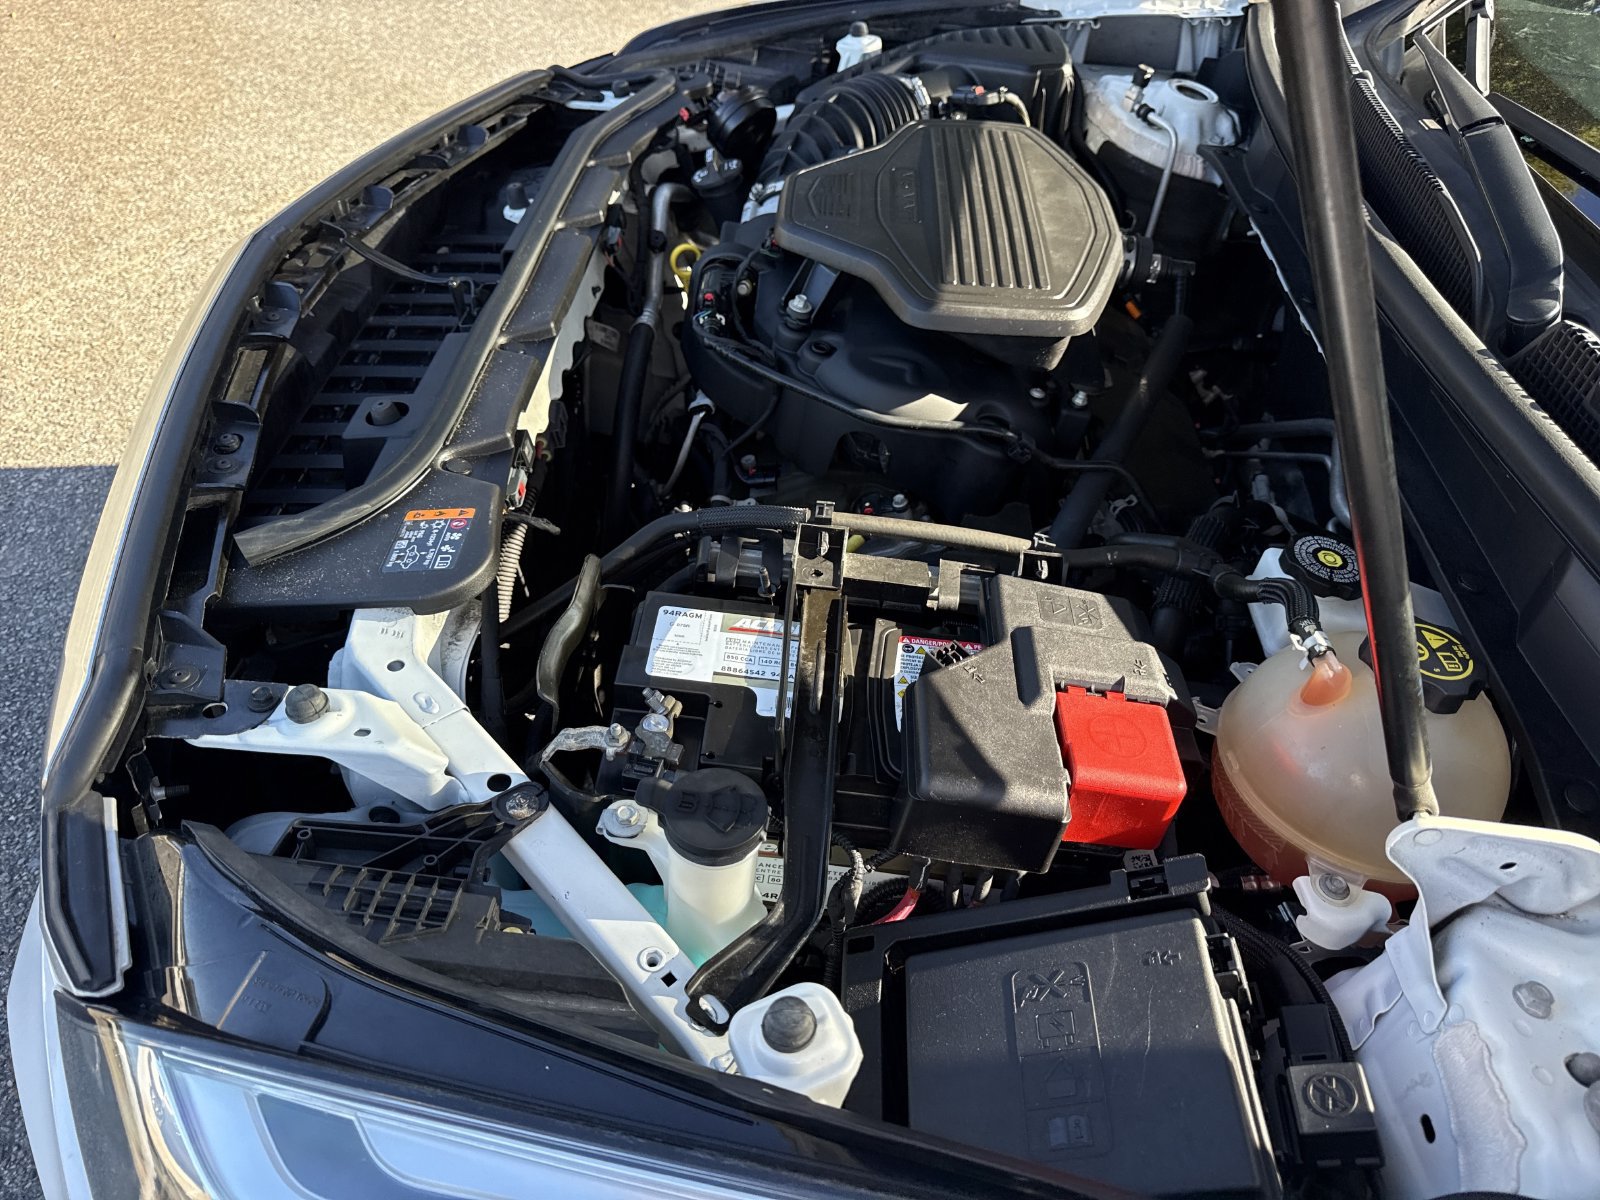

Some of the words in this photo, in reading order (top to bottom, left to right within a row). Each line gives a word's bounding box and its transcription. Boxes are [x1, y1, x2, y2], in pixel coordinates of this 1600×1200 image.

[663, 609, 703, 619] 94RAGM
[742, 640, 782, 648] MAINTENAN
[721, 666, 766, 676] 88864542
